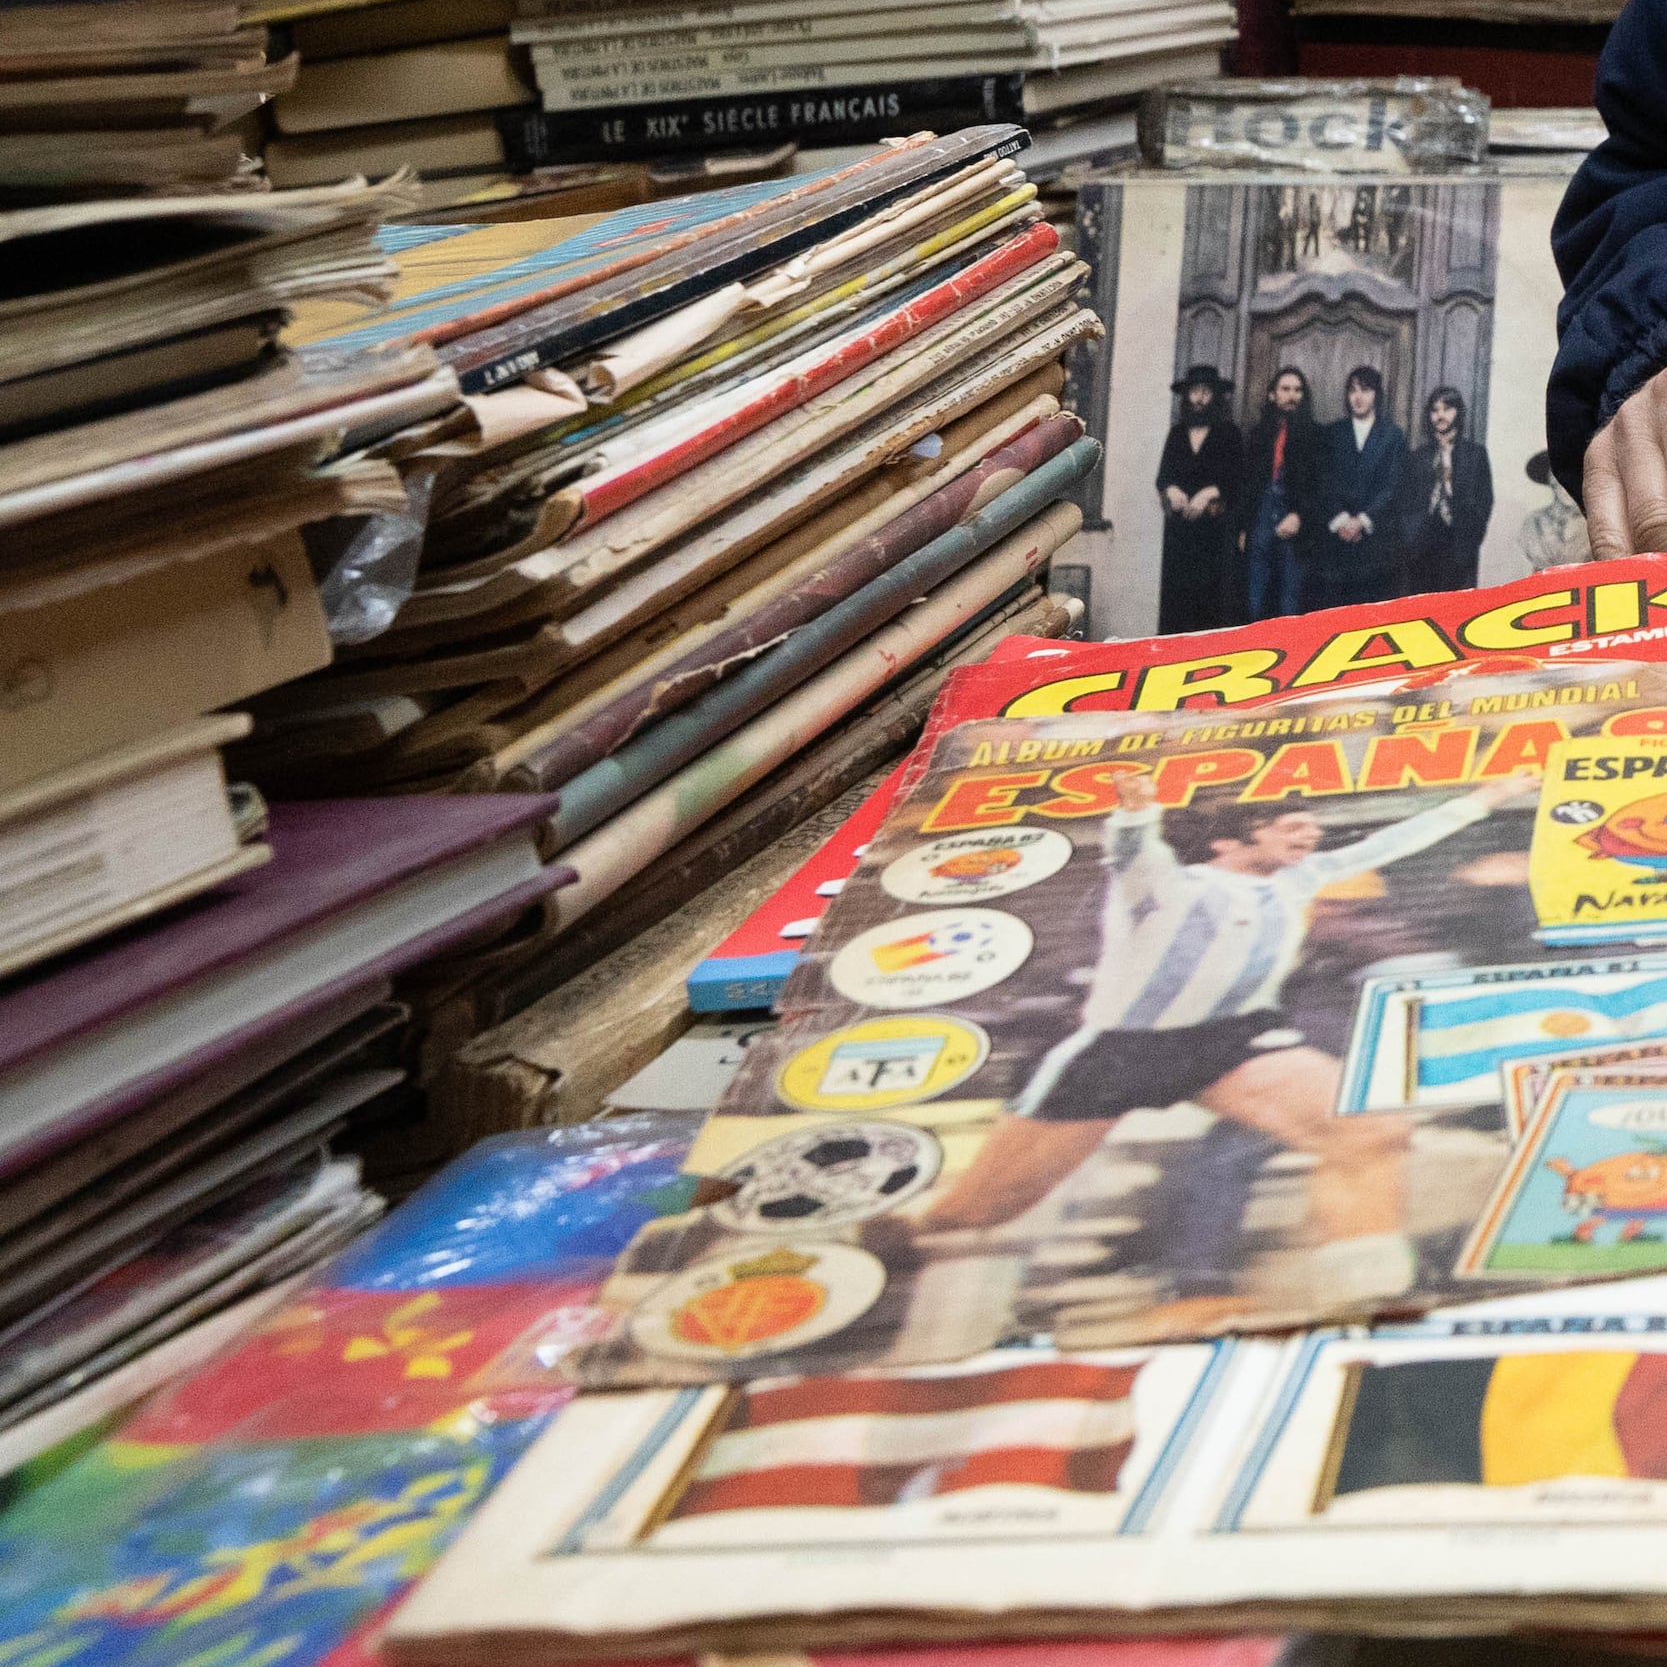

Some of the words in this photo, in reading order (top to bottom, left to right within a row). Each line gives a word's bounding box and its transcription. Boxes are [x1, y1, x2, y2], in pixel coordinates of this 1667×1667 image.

[602, 121, 626, 142] LE
[791, 91, 901, 126] FRANÇAIS
[967, 739, 1104, 769] ALBUM
[1114, 732, 1163, 754] DE
[1180, 709, 1377, 745] FIGURITAS
[1393, 701, 1453, 725] DEL
[1470, 679, 1641, 716] MUNDIAL
[918, 722, 1572, 834] ESPAÑA
